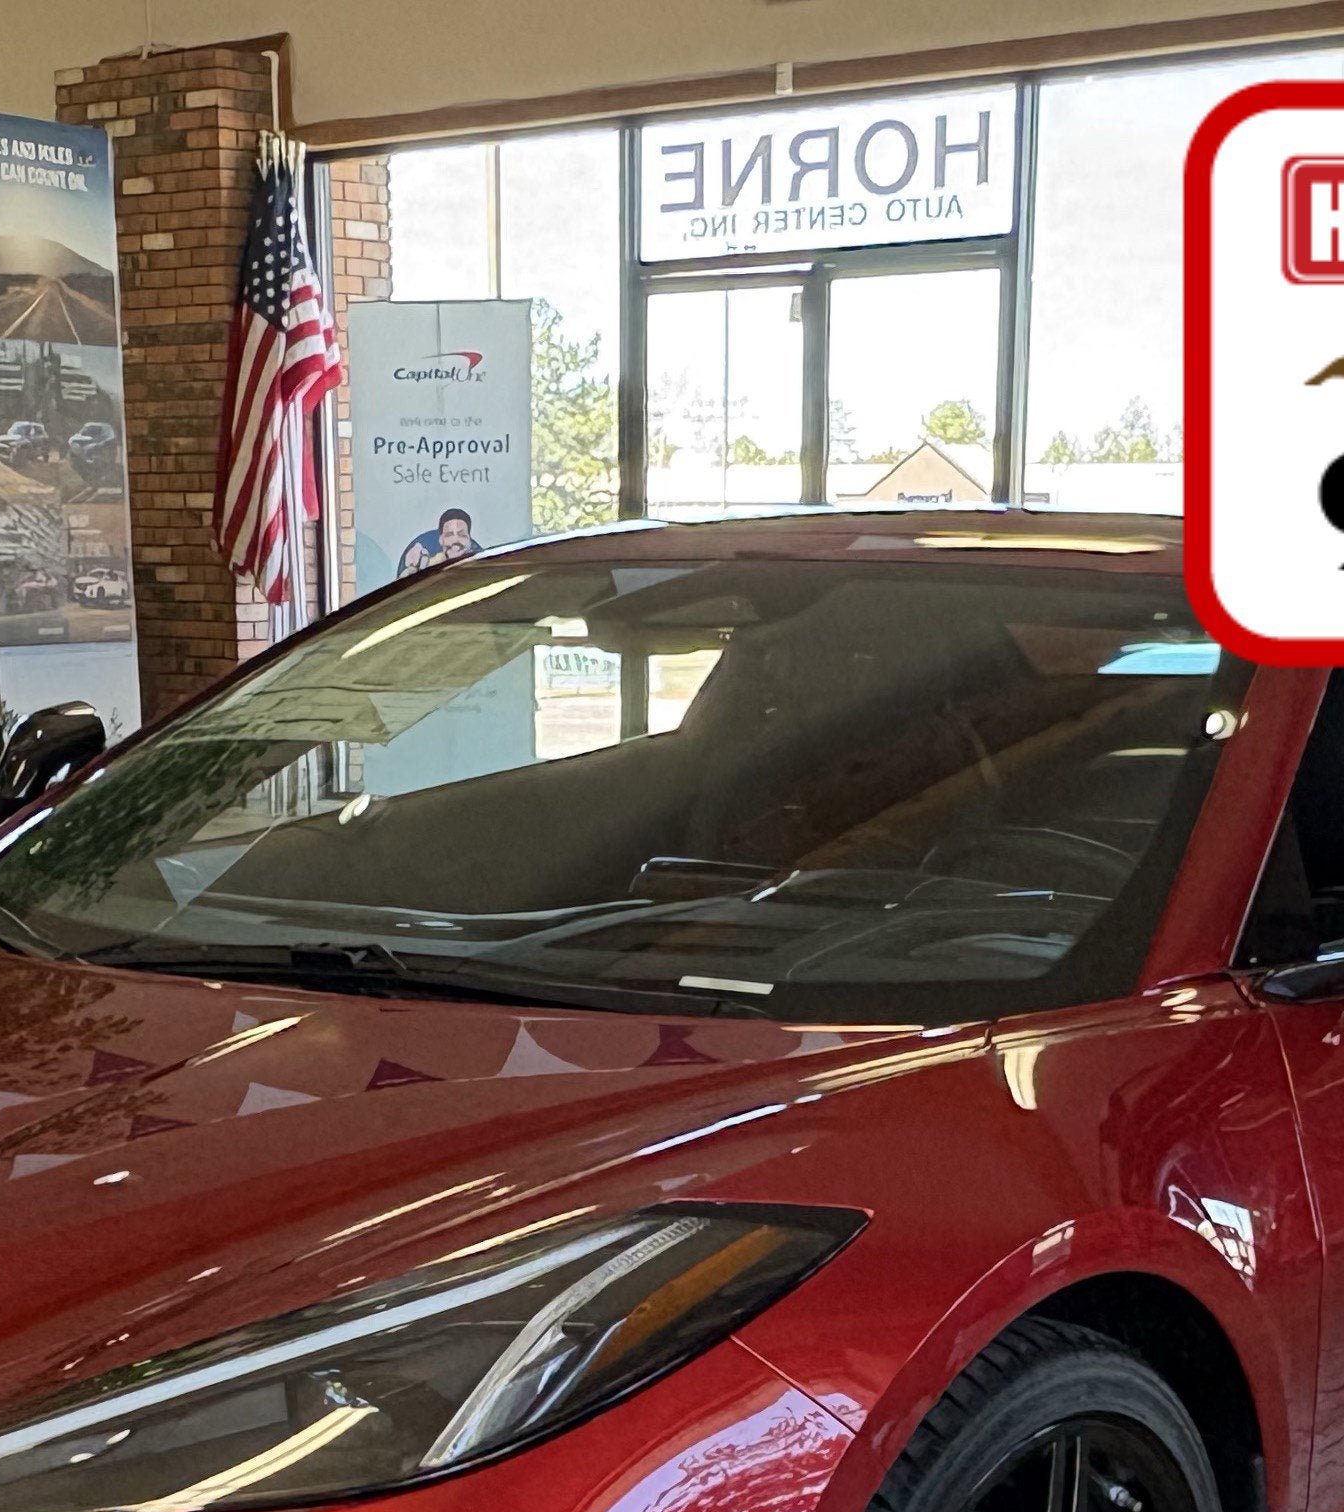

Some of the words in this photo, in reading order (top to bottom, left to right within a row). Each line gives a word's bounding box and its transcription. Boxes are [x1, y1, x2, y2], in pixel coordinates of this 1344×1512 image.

[11, 139, 37, 161] AND
[0, 162, 27, 183] CAN
[27, 166, 67, 190] COUNT
[373, 433, 510, 459] Pre-Approval
[392, 463, 433, 484] Sale
[439, 463, 490, 484] Event
